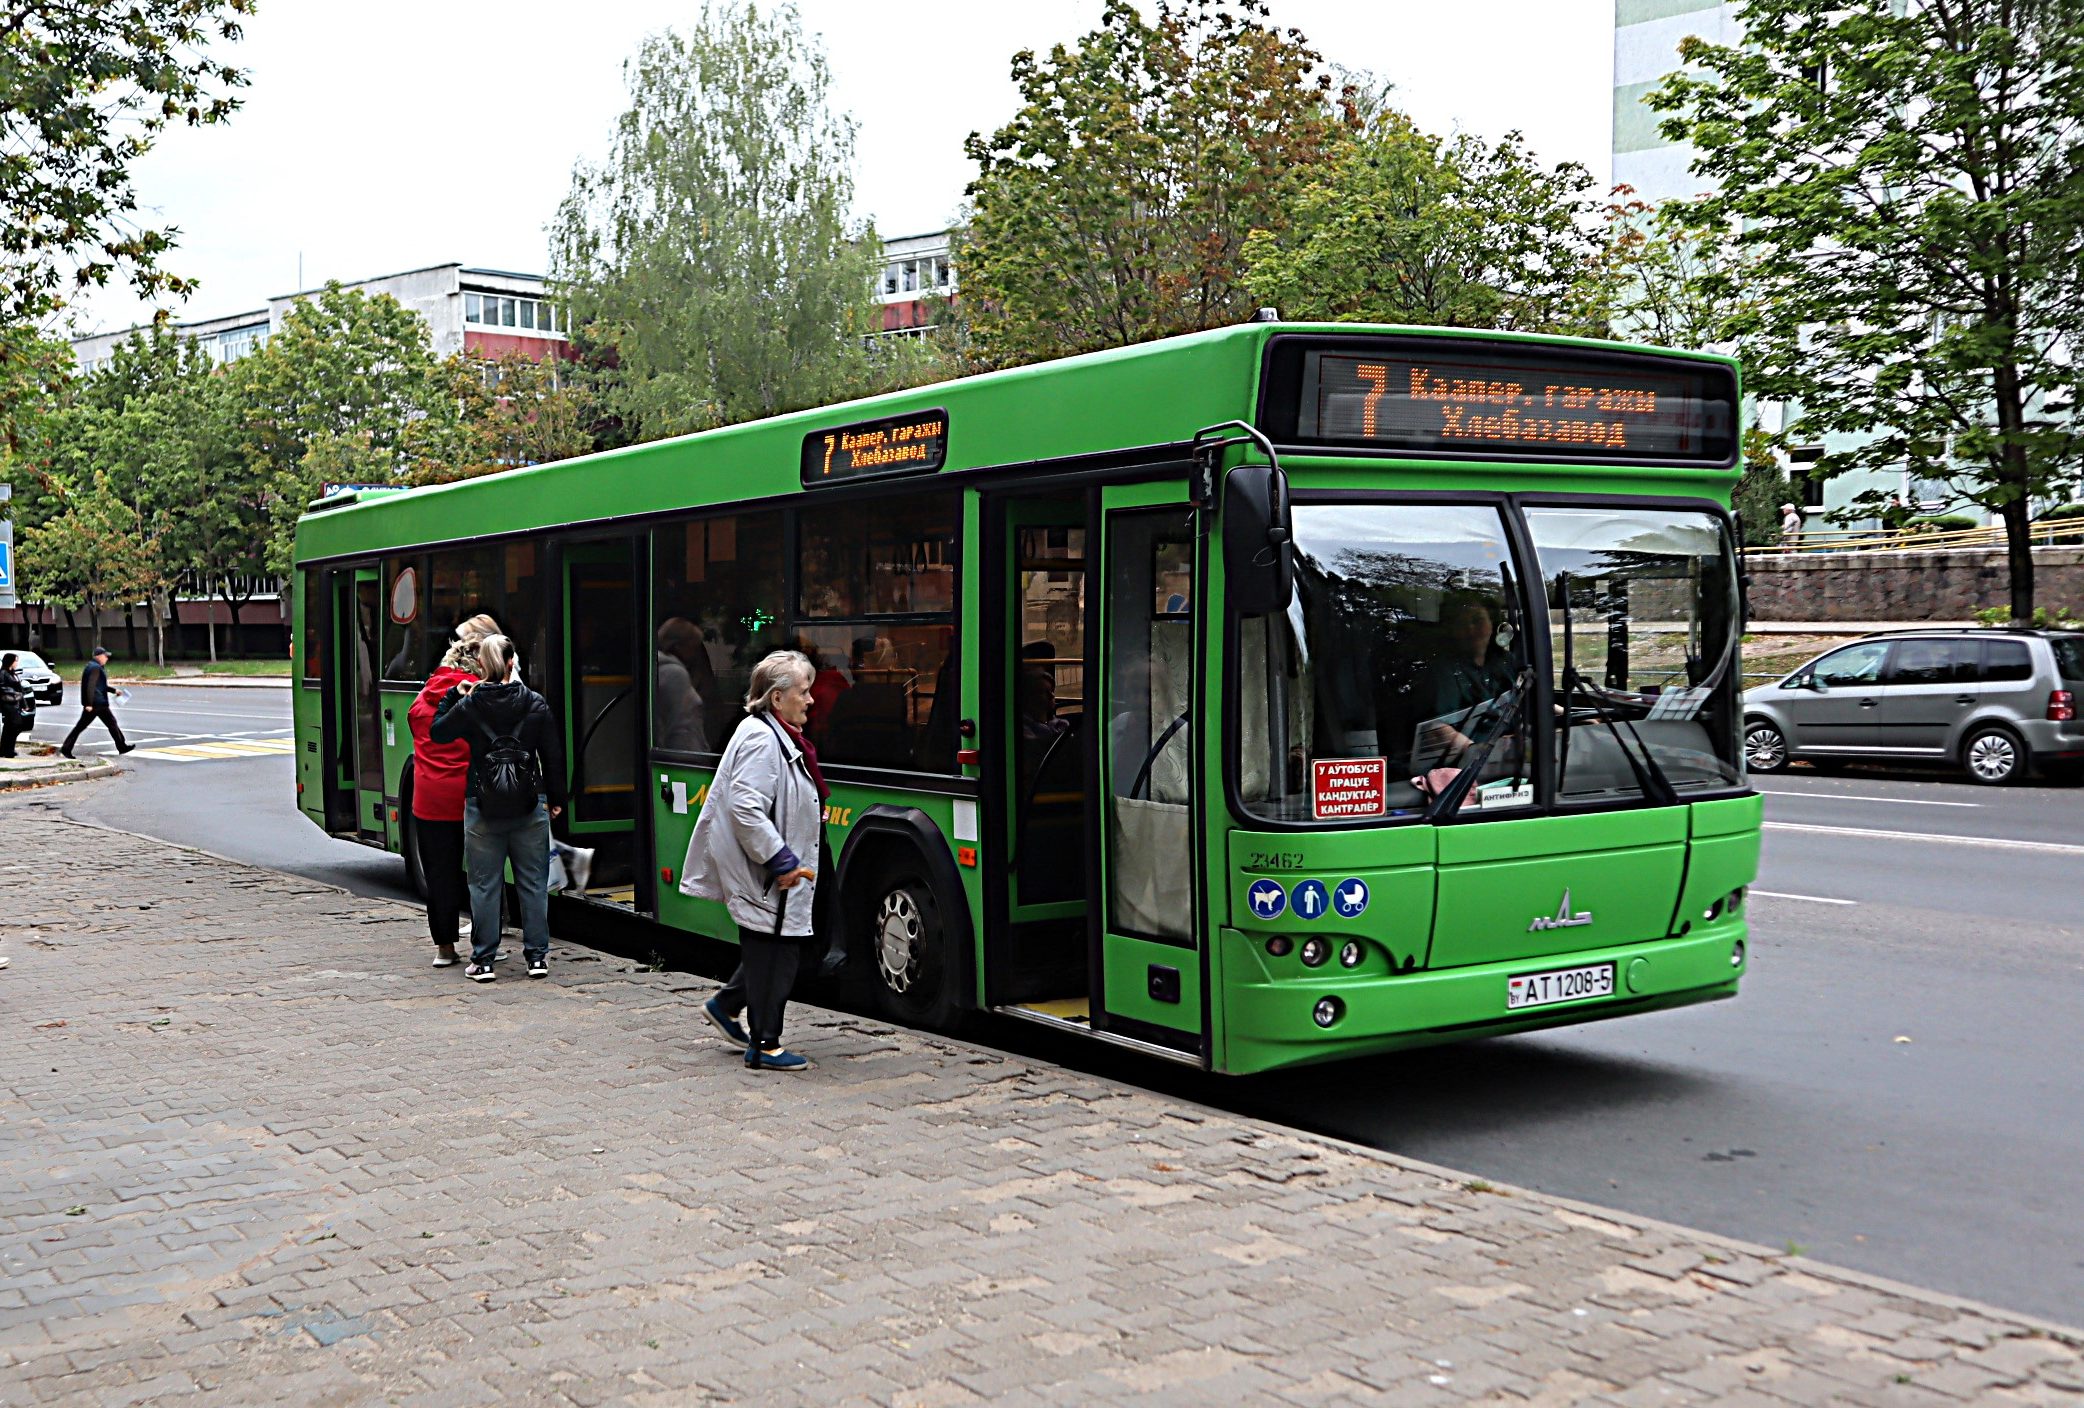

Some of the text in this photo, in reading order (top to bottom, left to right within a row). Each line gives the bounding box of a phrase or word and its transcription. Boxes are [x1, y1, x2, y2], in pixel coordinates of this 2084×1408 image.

[1358, 364, 1387, 438] 7
[1410, 367, 1656, 413] Каапер. гаражы
[841, 421, 942, 450] Каапер. гаражы
[1442, 405, 1626, 449] Хлебазавод
[823, 434, 836, 475] 7
[851, 443, 927, 468] Хлебазавод
[1319, 764, 1380, 775] У АЎТОБУСЕ
[1329, 777, 1370, 788] ПРАЦУЕ
[1318, 790, 1380, 802] КАНДУКТАР-
[1321, 801, 1379, 815] КАНТРАЛЁР
[1250, 853, 1304, 869] 23462
[1525, 968, 1612, 1003] AT 1208-5
